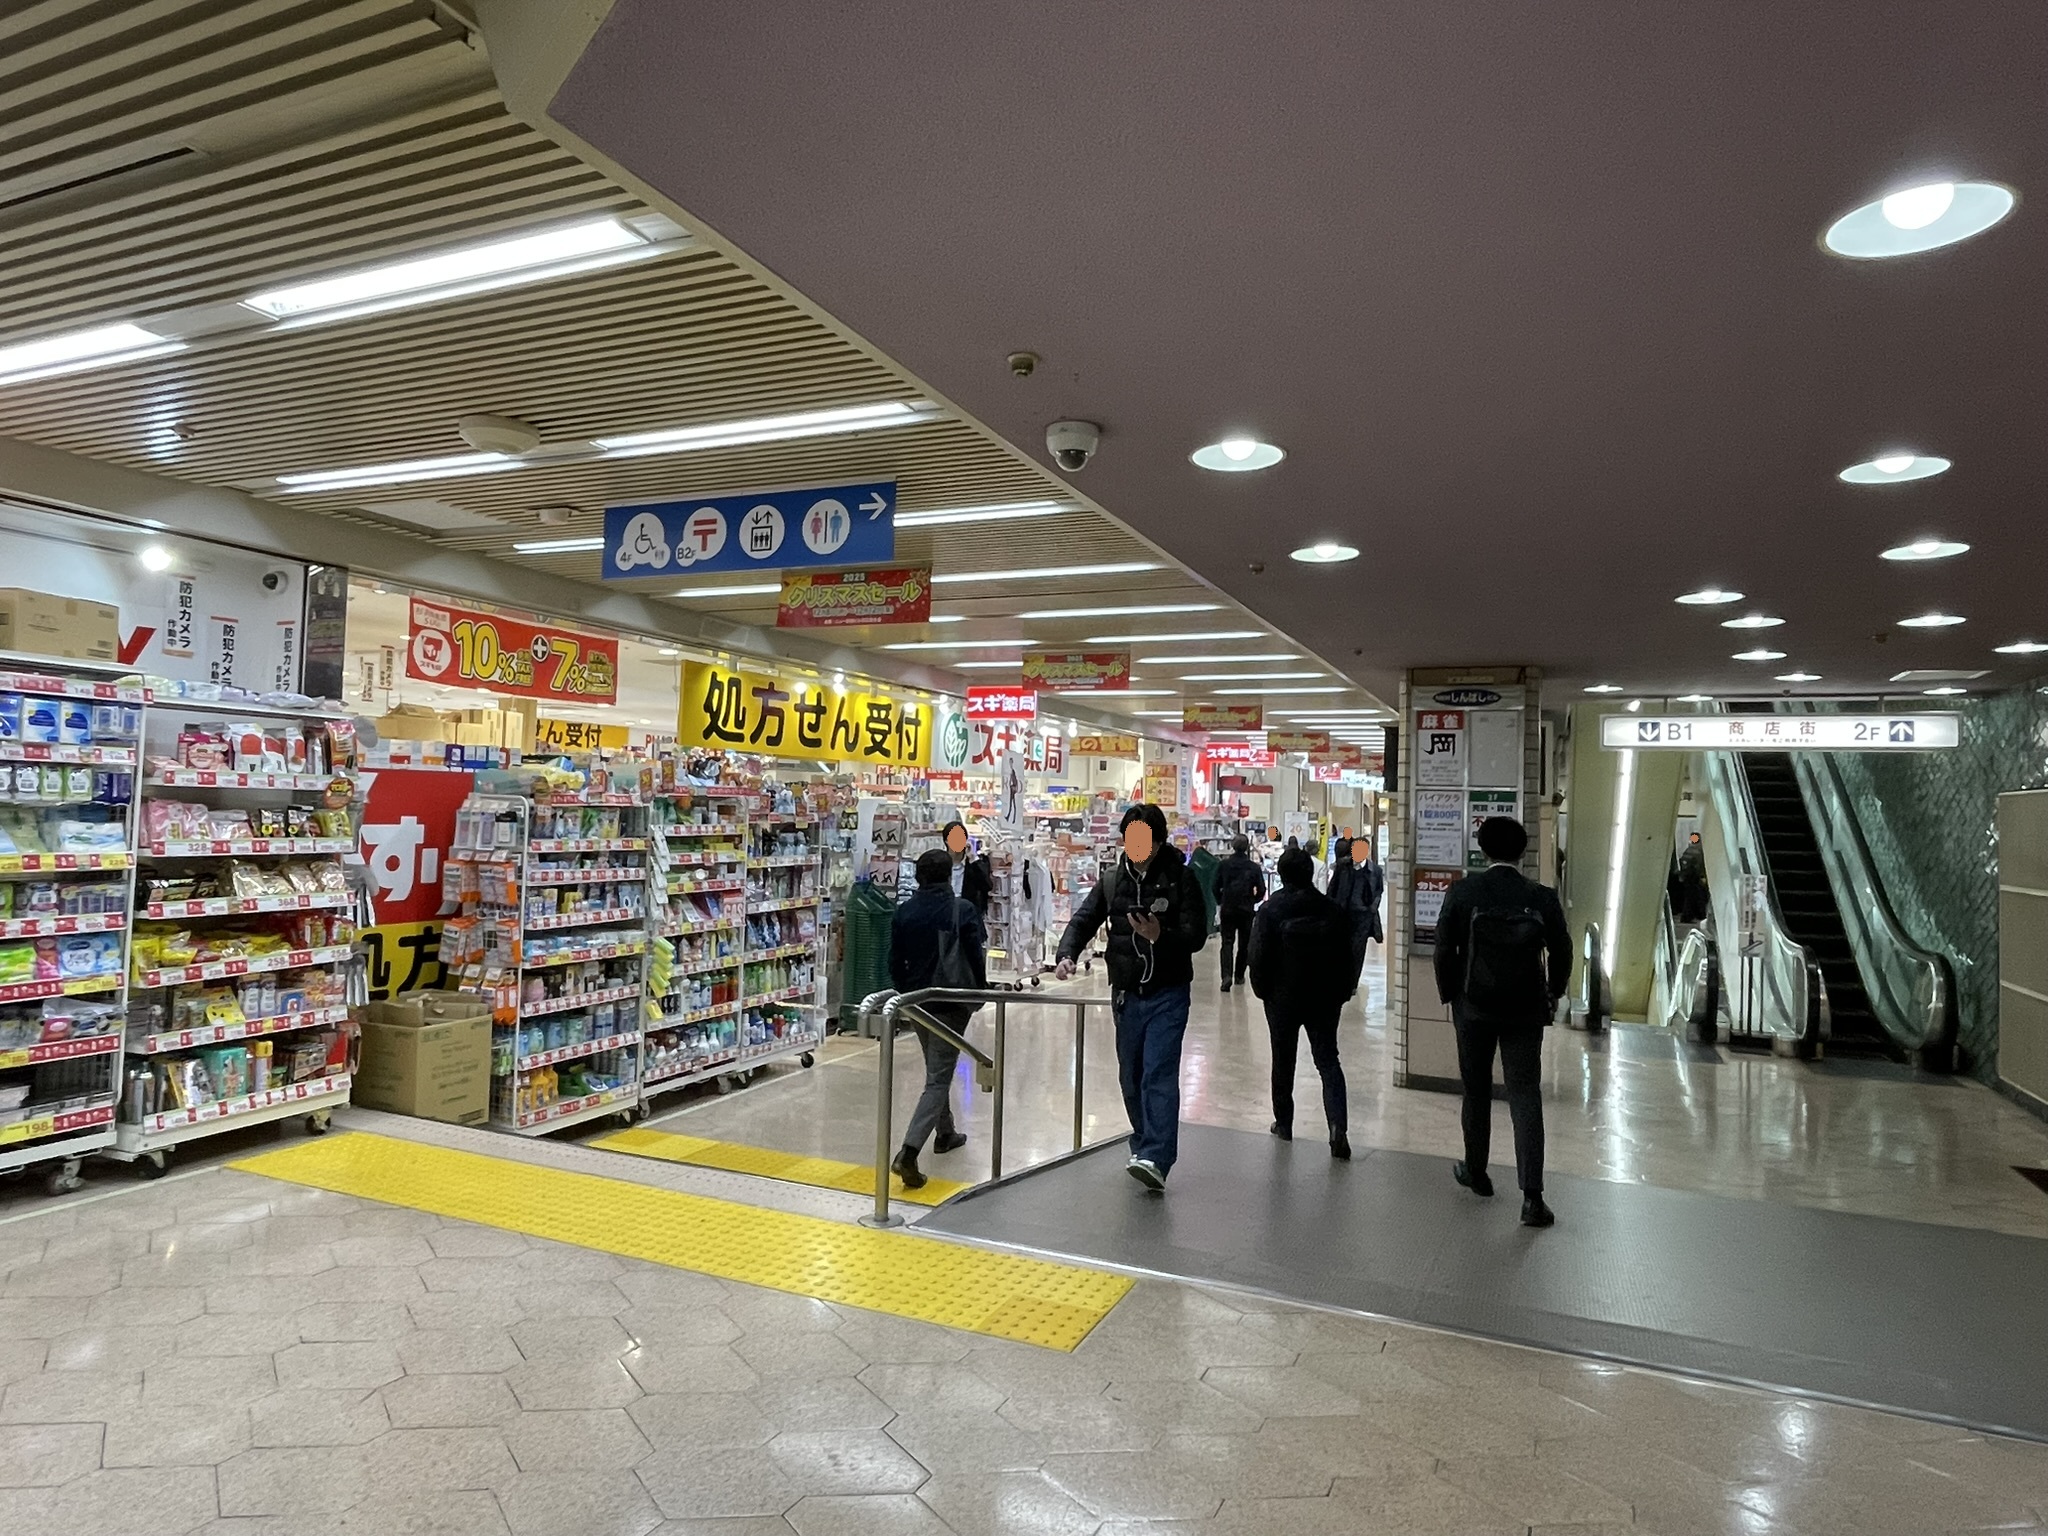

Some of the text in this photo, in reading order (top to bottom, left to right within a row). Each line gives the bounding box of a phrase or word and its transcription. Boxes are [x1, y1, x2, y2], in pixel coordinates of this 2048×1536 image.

[620, 552, 632, 562] 4F
[677, 547, 696, 560] B2F
[788, 580, 922, 607] クリスマスセール
[179, 581, 193, 648] 防犯カメラ
[282, 627, 293, 692] 防犯カメラ
[453, 620, 516, 683] 10%
[551, 639, 586, 691] 7%
[967, 694, 1035, 712] スギ薬局
[702, 671, 922, 762] 処方せん受付
[535, 719, 602, 748] ん受付
[1667, 723, 1693, 740] B1
[1729, 721, 1816, 735] 商店街
[1854, 722, 1881, 741] 2F
[187, 843, 208, 852] 328
[25, 1122, 49, 1134] 198
